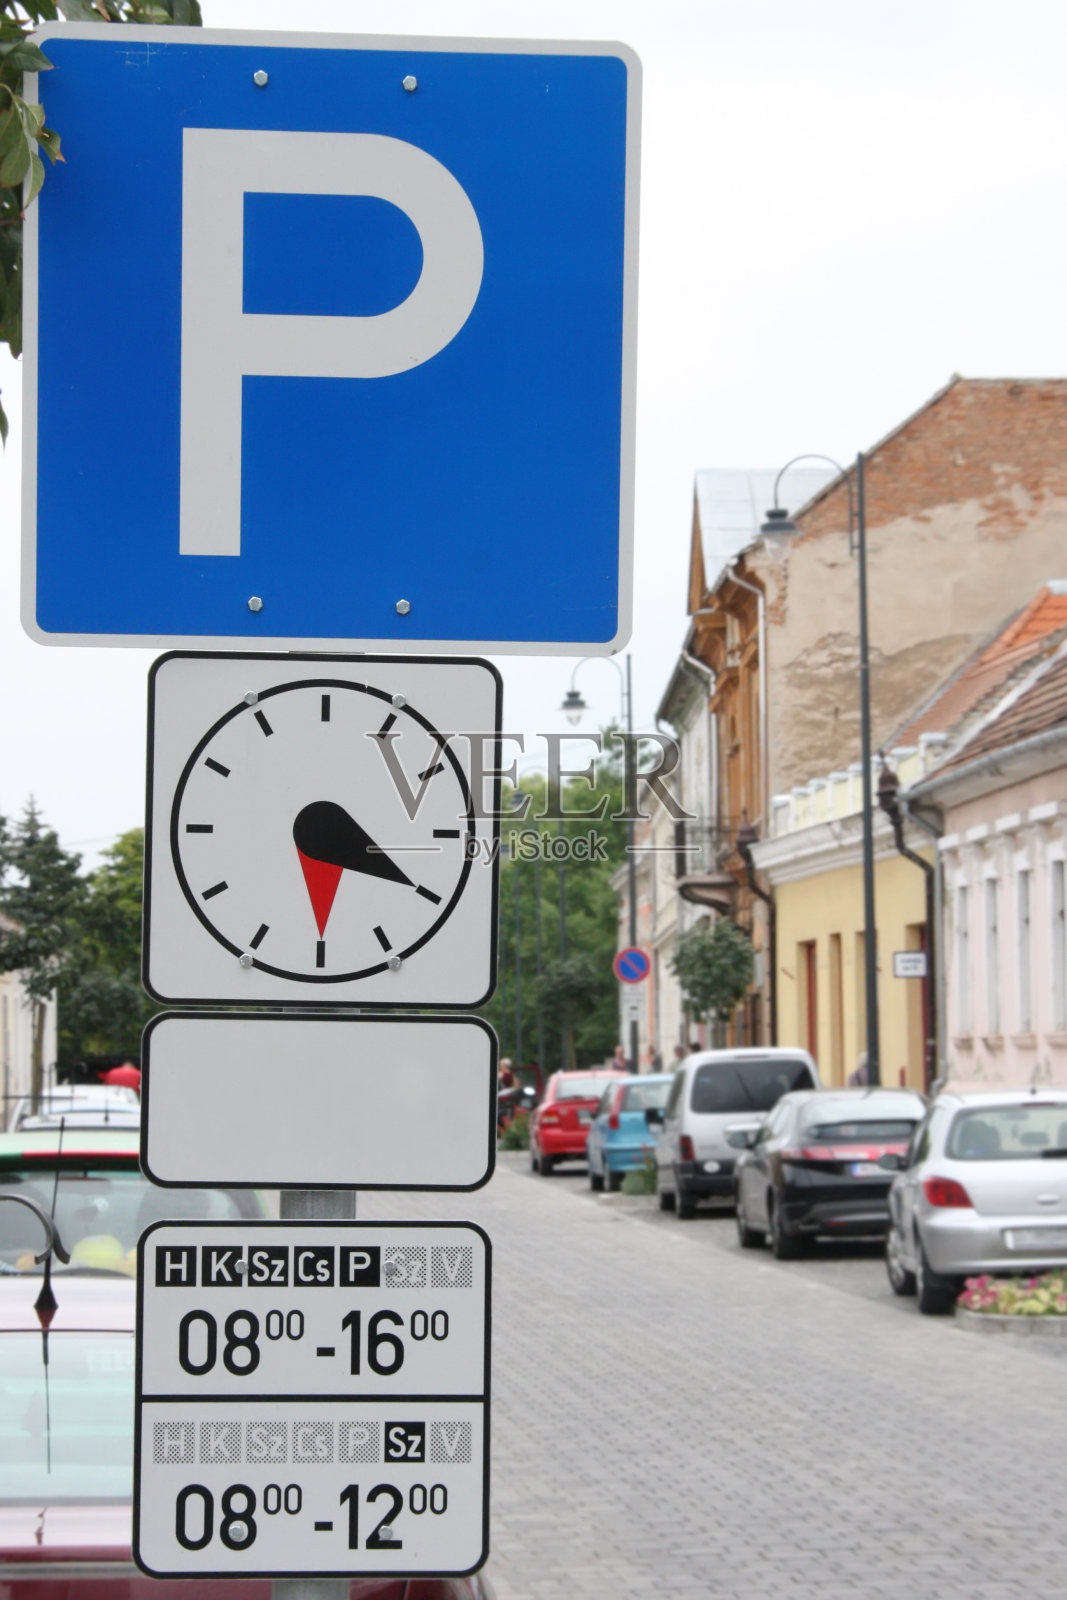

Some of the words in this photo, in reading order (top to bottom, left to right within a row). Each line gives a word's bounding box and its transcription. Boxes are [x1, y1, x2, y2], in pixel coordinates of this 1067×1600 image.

[179, 127, 485, 557] P
[165, 1251, 187, 1282] H
[211, 1251, 233, 1282] K
[252, 1251, 285, 1282] Sz
[298, 1251, 331, 1282] Cs
[349, 1251, 372, 1282] P
[440, 1251, 463, 1282] V
[388, 1426, 422, 1458] Sz
[439, 1427, 462, 1458] V
